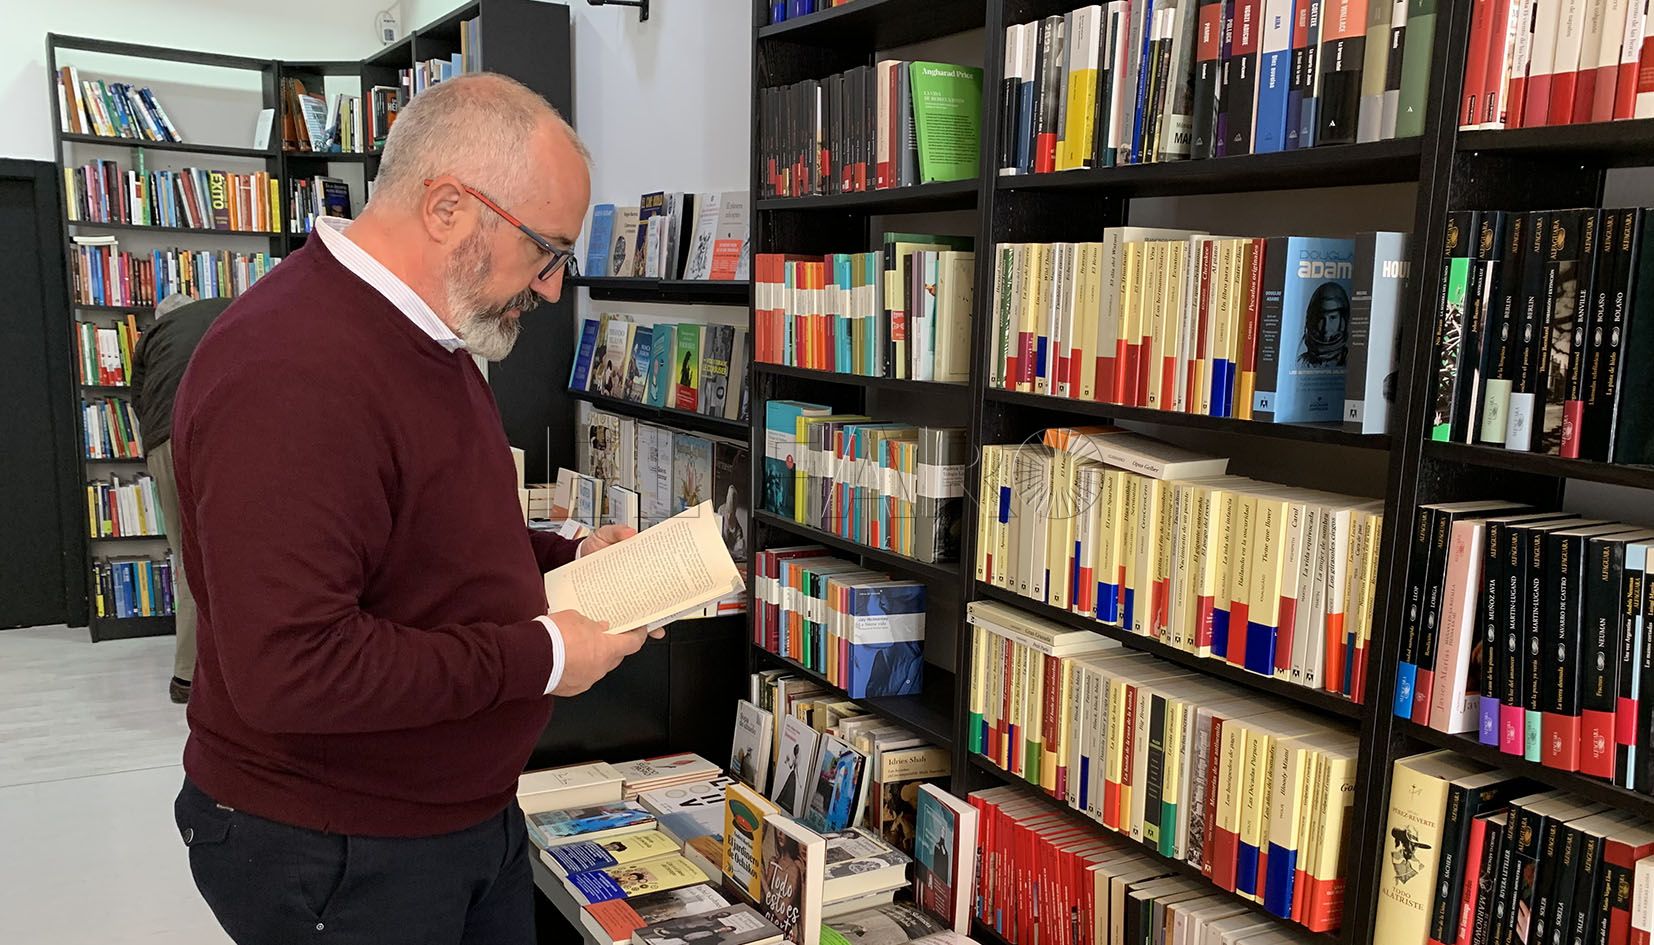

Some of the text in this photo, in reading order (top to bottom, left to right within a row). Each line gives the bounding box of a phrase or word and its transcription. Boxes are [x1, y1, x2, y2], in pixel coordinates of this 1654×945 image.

[1310, 3, 1318, 27] COETZEE
[1338, 6, 1348, 33] WALLACE
[1241, 24, 1249, 46] ADICHIE
[922, 67, 974, 79] Angharad Price
[1269, 55, 1278, 88] Diez novelas
[1445, 219, 1456, 256] ALFAGUARA
[1478, 221, 1490, 258] ALFAGUARA
[1511, 218, 1522, 253] ALFAGUARA
[1534, 217, 1544, 253] ALFAGUARA
[1550, 219, 1562, 260] ALFAGUARA
[1584, 216, 1595, 254] ALFAGUARA
[1604, 215, 1615, 252] ALFAGUARA
[1622, 213, 1633, 251] ALFAGUARA
[1221, 302, 1226, 311] Un
[1504, 295, 1512, 319] BERLIN
[1577, 289, 1587, 322] BANVILLE
[1597, 293, 1606, 322] BOLAÑO
[1614, 292, 1623, 322] BOLAÑO
[1264, 508, 1272, 527] llover
[1321, 513, 1329, 539] sombra
[1418, 510, 1428, 543] ALFAGUARA
[1436, 516, 1447, 549] ALFAGUARA
[1224, 534, 1229, 542] de
[1302, 567, 1308, 577] La
[1305, 511, 1314, 551] equivocada
[1320, 541, 1326, 550] de
[1489, 525, 1499, 559] ALFAGUARA
[1222, 556, 1227, 565] La
[1602, 546, 1610, 581] ALFAGUARA
[1317, 573, 1323, 582] La
[1430, 585, 1438, 608] LORIGA
[1560, 602, 1566, 610] DE
[1633, 578, 1641, 608] ALFAGUARA
[1598, 617, 1606, 648] NEUMAN
[1437, 649, 1450, 712] Javier Marías
[888, 755, 927, 766] Idries Shah
[1250, 739, 1259, 766] Púrpura
[1209, 776, 1217, 807] Memorias
[1213, 765, 1218, 773] de
[1248, 768, 1256, 795] Décadas
[1280, 771, 1288, 796] Bloody
[1451, 792, 1460, 821] ALFAGUARA
[1506, 809, 1516, 840] ALFAGUARA
[1518, 817, 1528, 851] ALFAGUARA
[1547, 825, 1557, 857] ALFAGUARA
[1564, 833, 1573, 865] ALFAGUARA
[1585, 840, 1594, 873] ALFAGUARA
[770, 862, 793, 897] Todo
[1500, 850, 1511, 898] RIVERA LETELIER
[765, 891, 786, 914] esto
[786, 904, 800, 924] es
[1382, 887, 1425, 913] ALATRISTE
[1392, 886, 1412, 900] TODO
[1539, 897, 1547, 917] SOLER
[1556, 902, 1564, 926] SORELA
[1577, 912, 1585, 934] TALESE
